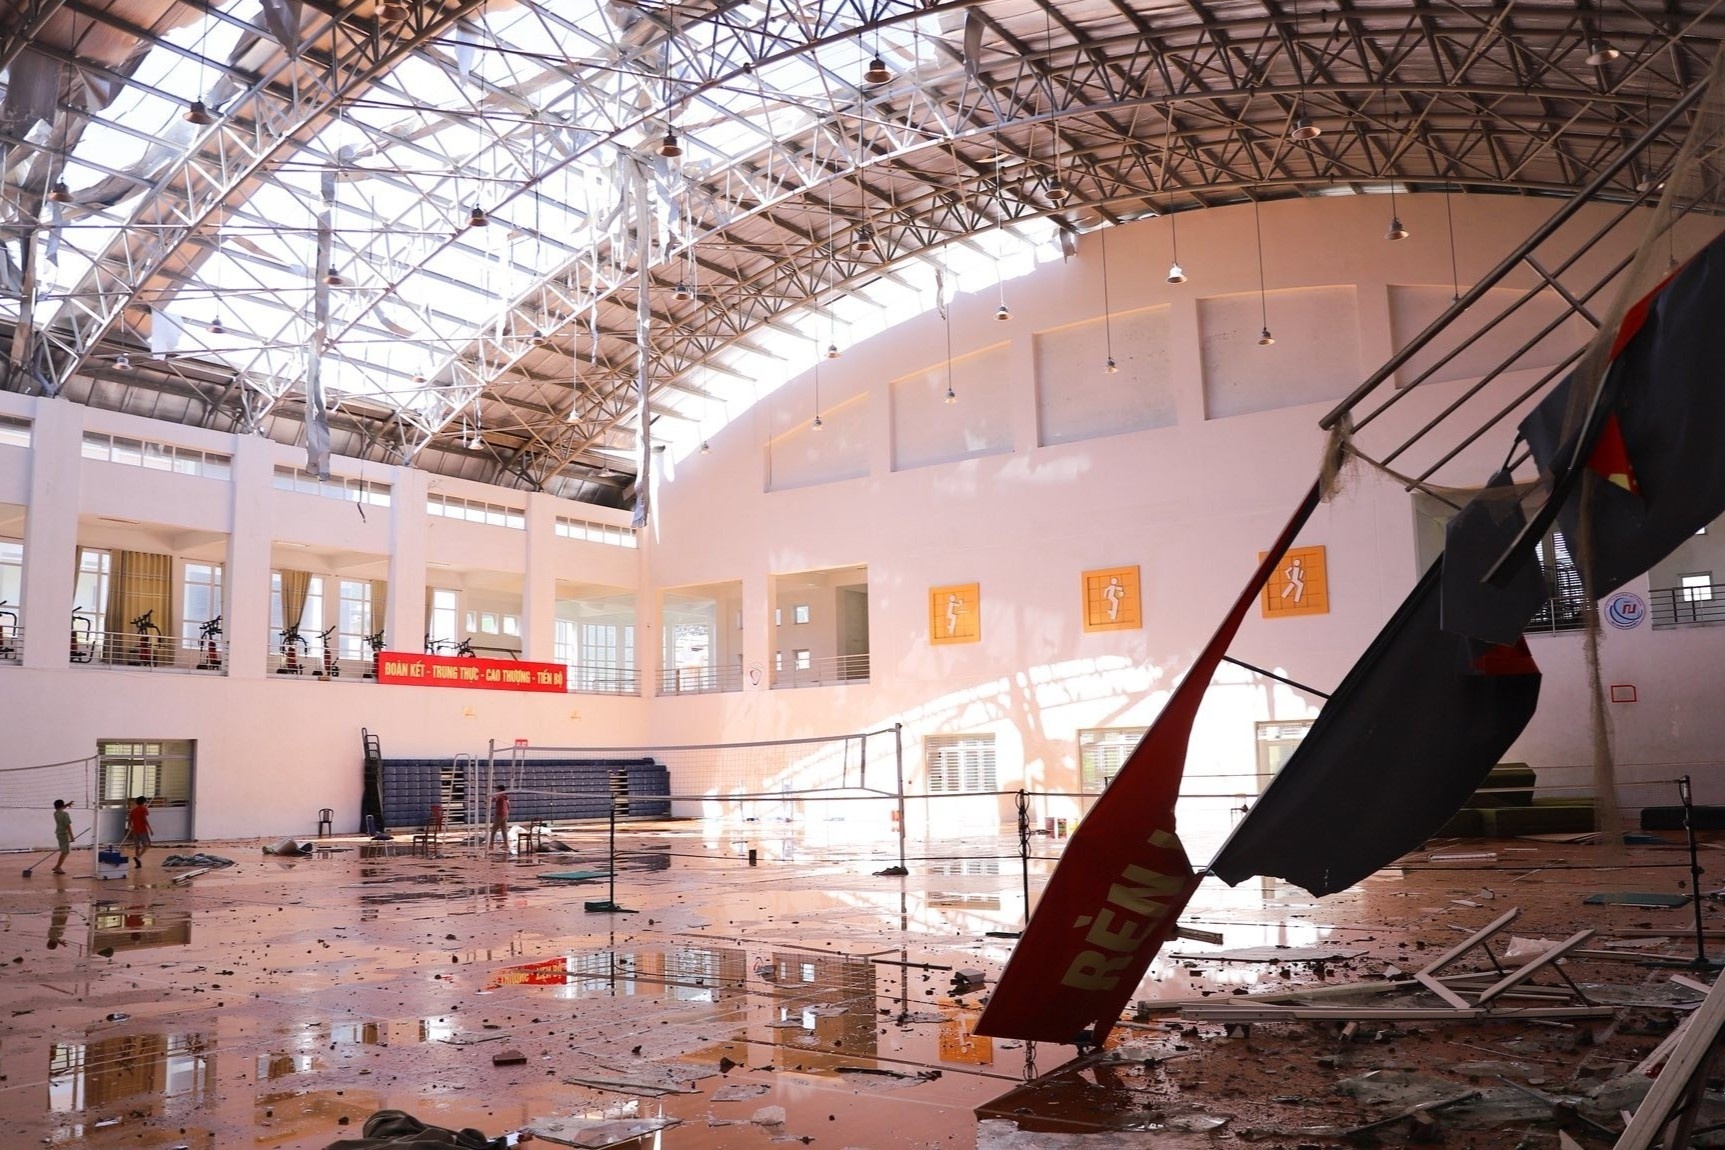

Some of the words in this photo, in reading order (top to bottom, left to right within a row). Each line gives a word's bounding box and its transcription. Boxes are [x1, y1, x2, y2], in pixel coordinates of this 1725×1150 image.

[410, 660, 425, 678] KẾT
[432, 665, 458, 679] TRUNG
[460, 666, 479, 683] THỰC
[485, 668, 501, 682] CAO
[502, 669, 531, 686] THƯỢNG
[537, 669, 553, 685] TIẾN
[553, 671, 563, 688] BỘ
[1061, 864, 1186, 991] RÈN
